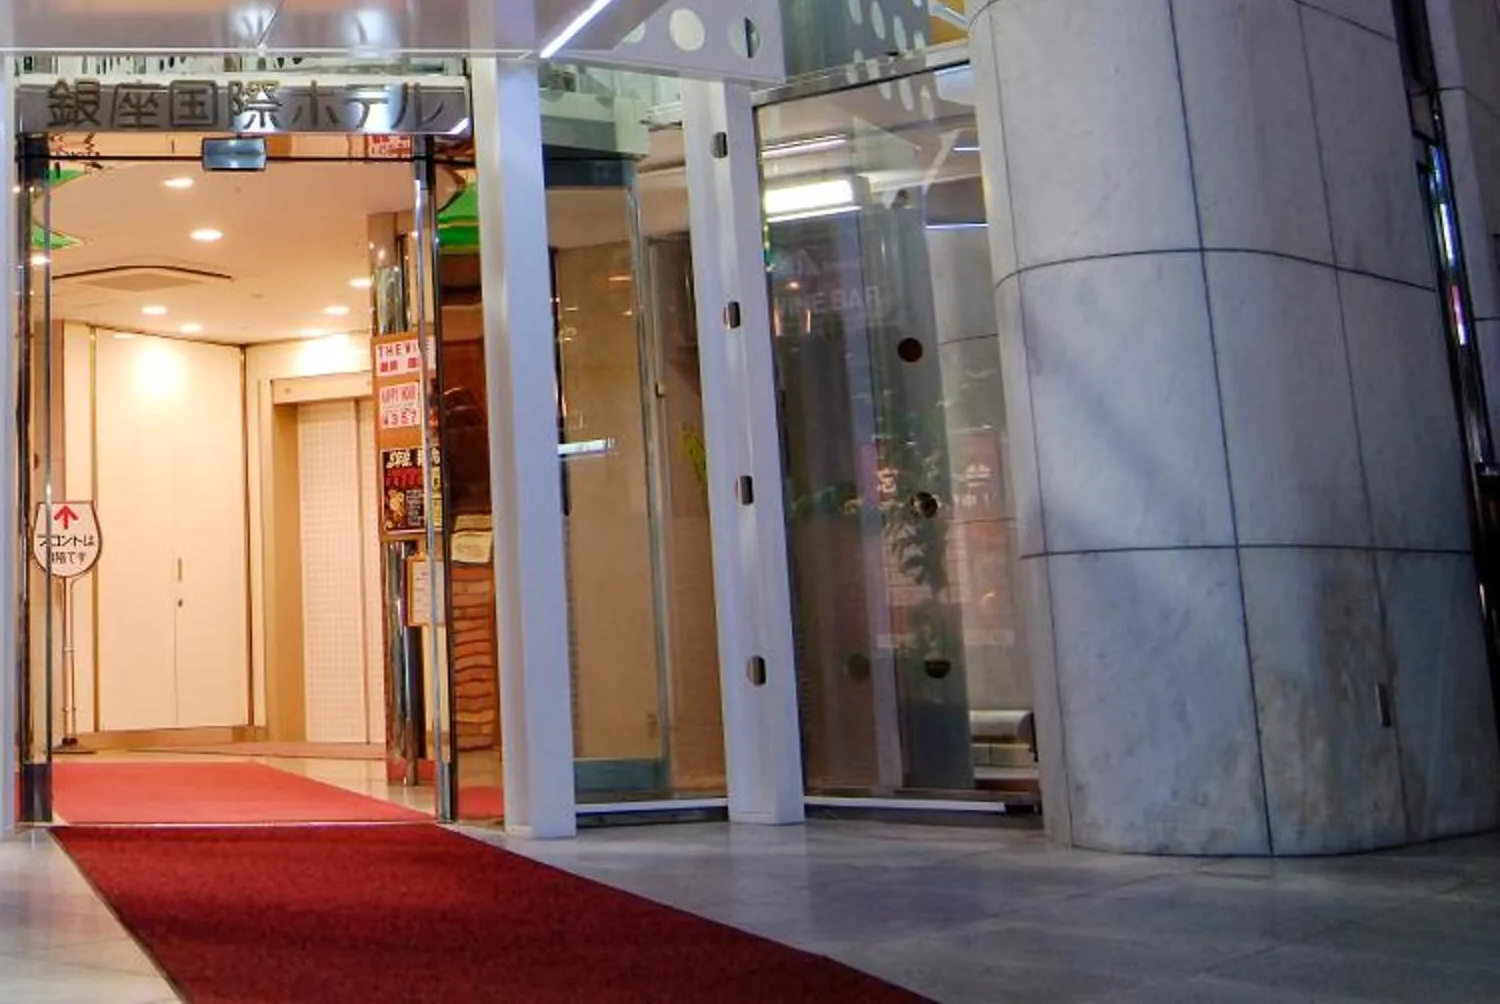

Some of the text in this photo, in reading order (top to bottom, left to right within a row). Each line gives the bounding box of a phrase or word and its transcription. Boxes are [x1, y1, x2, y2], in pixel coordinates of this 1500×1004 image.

[46, 78, 445, 129] 銀座国際ホテル
